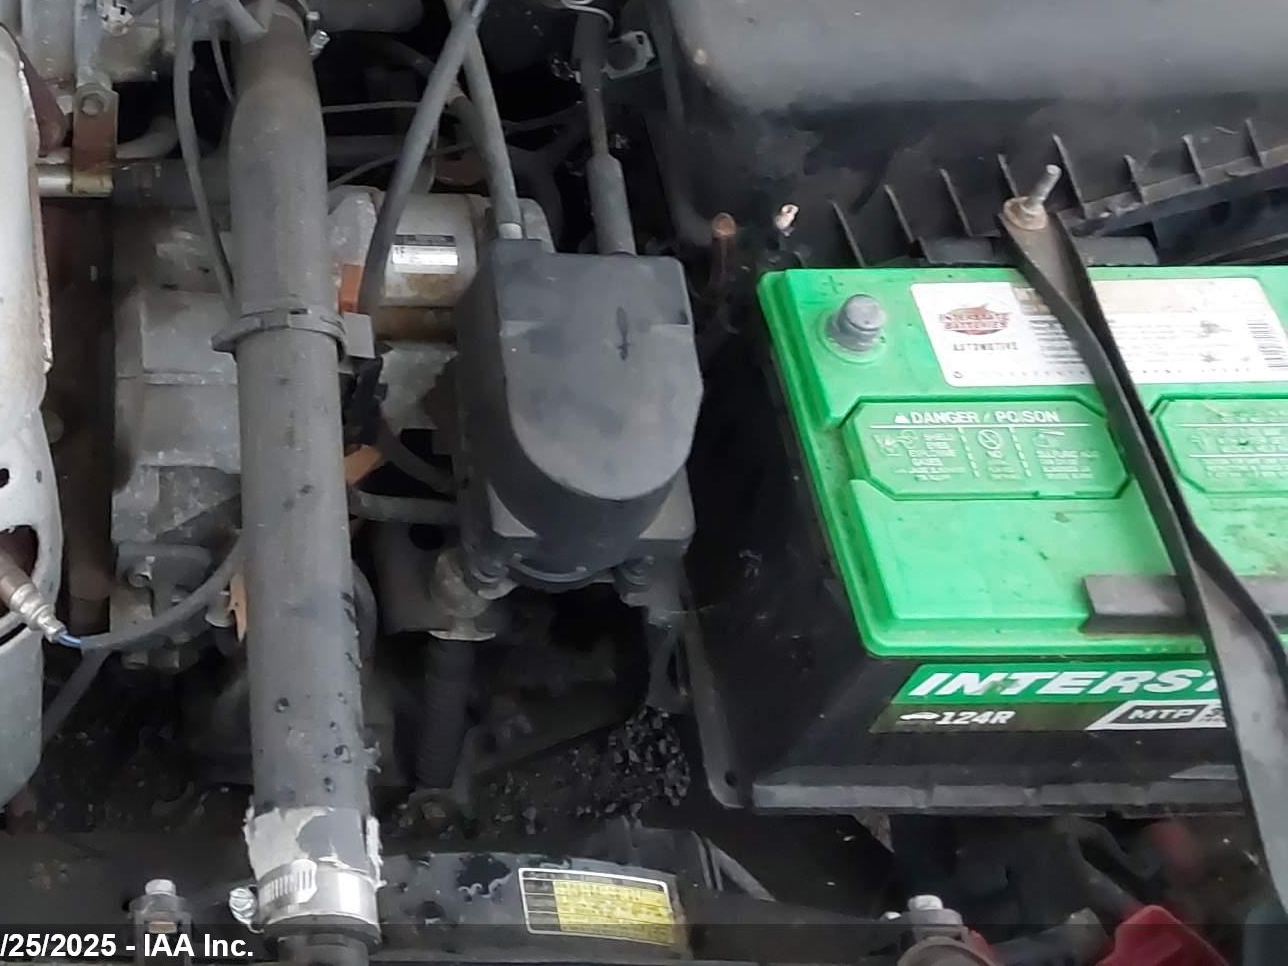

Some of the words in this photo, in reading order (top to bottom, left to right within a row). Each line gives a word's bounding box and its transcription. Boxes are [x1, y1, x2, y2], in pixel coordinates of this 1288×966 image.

[910, 411, 980, 424] DANGER
[994, 410, 1060, 423] POISON
[935, 710, 1016, 726] 124R
[1128, 708, 1198, 721] MTP
